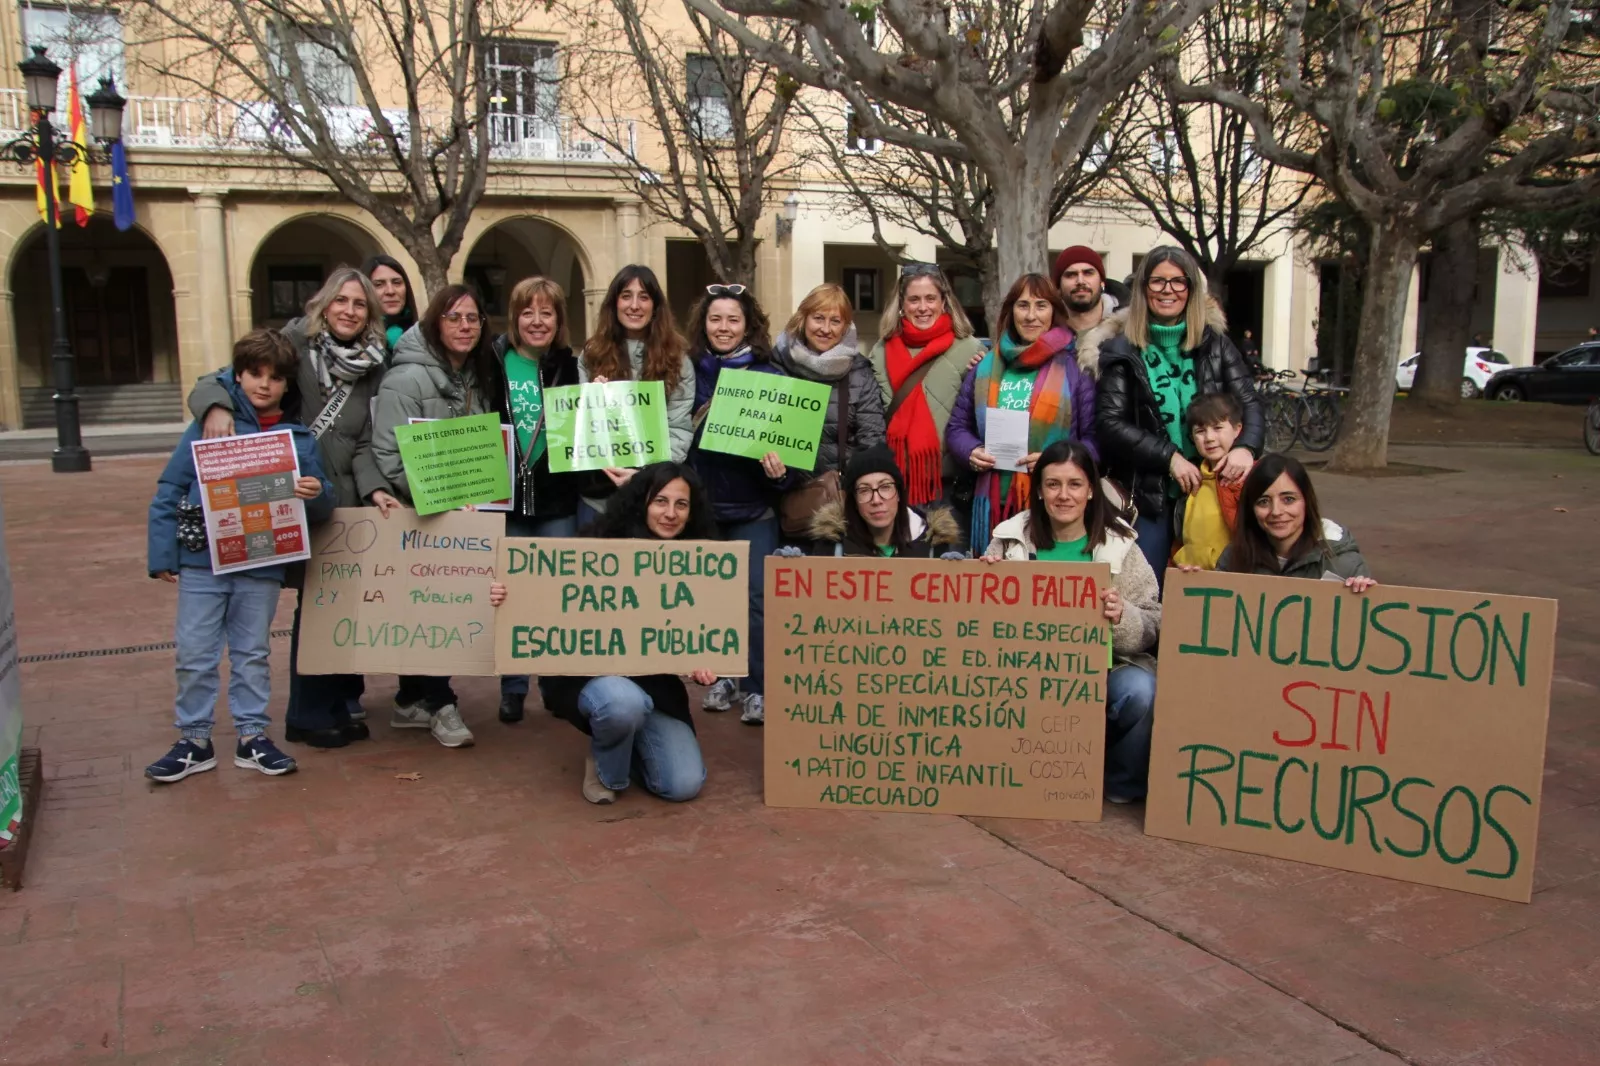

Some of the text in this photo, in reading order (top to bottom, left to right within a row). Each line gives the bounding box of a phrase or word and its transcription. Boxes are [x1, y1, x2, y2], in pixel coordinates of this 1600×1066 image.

[322, 389, 347, 418] BIMBA
[554, 388, 651, 413] INCLUSIÓN
[716, 386, 822, 412] DINERO PÚBLICO
[319, 418, 329, 426] Y
[591, 418, 619, 433] SIN
[739, 407, 783, 424] PARA LA
[254, 435, 279, 444] dinero
[424, 432, 440, 441] ESTE
[440, 428, 465, 438] CENTRO
[466, 425, 489, 434] FALTA:
[706, 422, 814, 453] ESCUELA PÚBLICA
[199, 449, 227, 459] público
[242, 442, 285, 453] concertada
[220, 452, 257, 464] supondría
[259, 450, 275, 459] para
[564, 440, 655, 460] RECURSOS
[242, 458, 269, 469] pública
[274, 477, 286, 486] 50
[276, 531, 299, 541] 4000
[318, 519, 378, 555] 20
[321, 562, 361, 582] PARA
[374, 564, 396, 576] LA
[410, 563, 496, 579] CONCERTADA
[363, 590, 385, 603] LA
[562, 581, 695, 613] PARA LA
[775, 568, 812, 599] EN
[826, 570, 894, 602] ESTE
[910, 572, 1020, 606] CENTRO
[957, 620, 979, 638] DE
[1178, 586, 1531, 687] INCLUSIÓN
[511, 625, 627, 659] ESCUELA
[922, 646, 947, 668] DE
[962, 649, 992, 668] ED.
[857, 703, 886, 728] DE
[1041, 715, 1081, 734] CEIP
[1272, 681, 1391, 755] SIN
[877, 760, 906, 782] DE
[1029, 759, 1087, 780] COSTA
[819, 784, 940, 808] ADECUADO
[1177, 744, 1533, 879] RECURSOS
